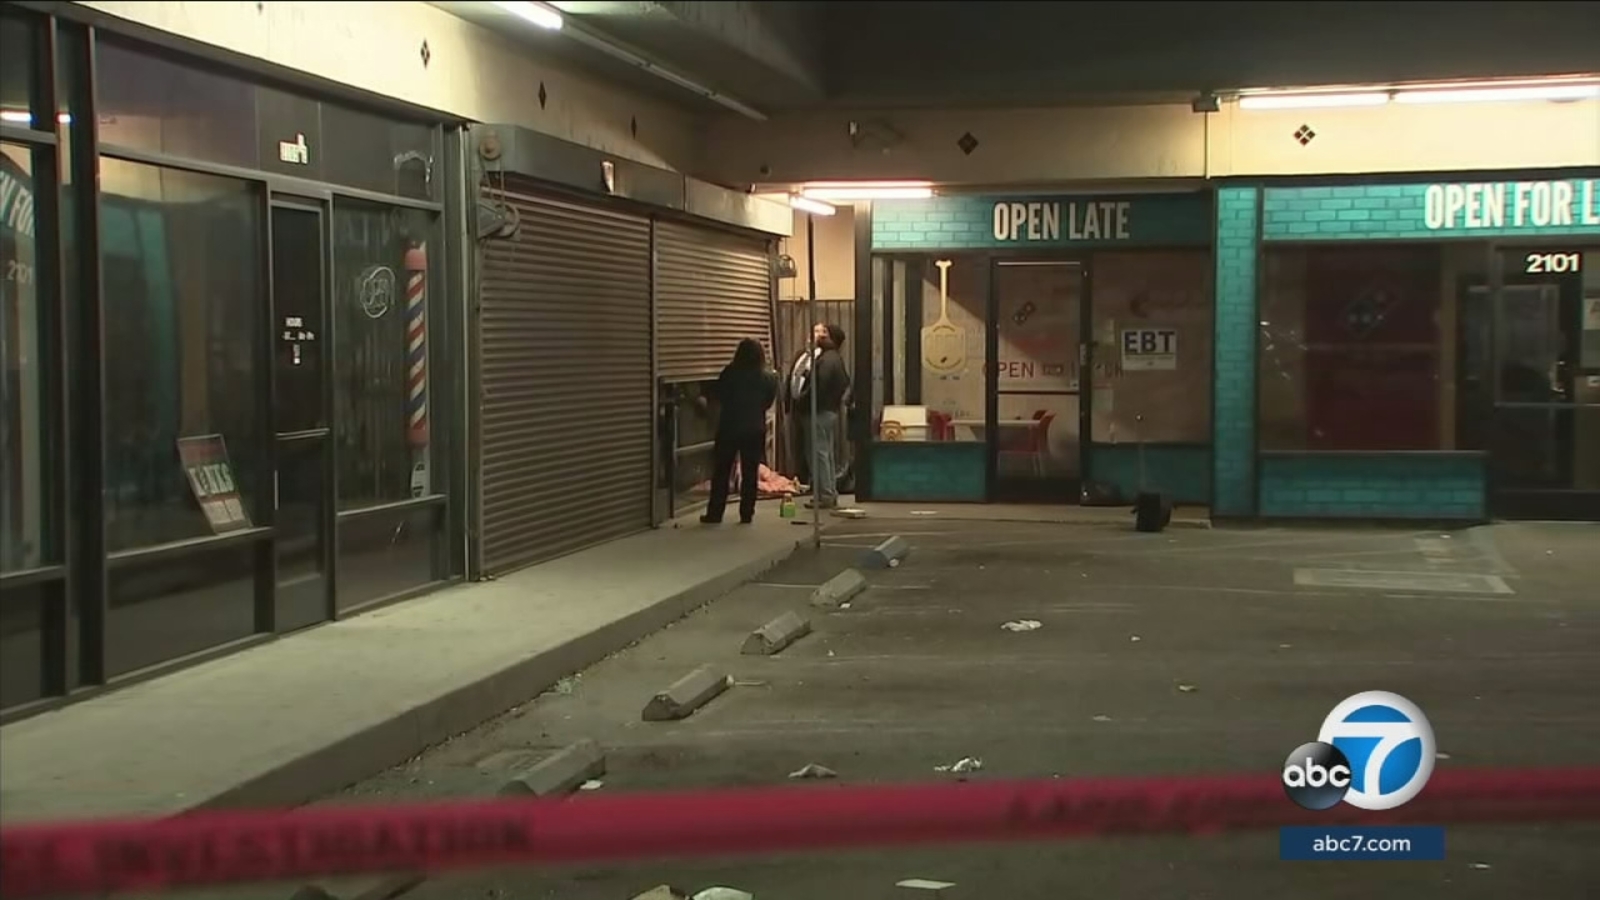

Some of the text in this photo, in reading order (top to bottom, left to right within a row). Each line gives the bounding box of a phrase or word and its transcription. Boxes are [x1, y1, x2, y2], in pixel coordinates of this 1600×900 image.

[1424, 178, 1600, 230] OPEN FOR L
[994, 202, 1131, 240] OPEN LATE
[1526, 253, 1580, 273] 2101
[1124, 331, 1175, 354] EBT
[983, 361, 1035, 378] PEN
